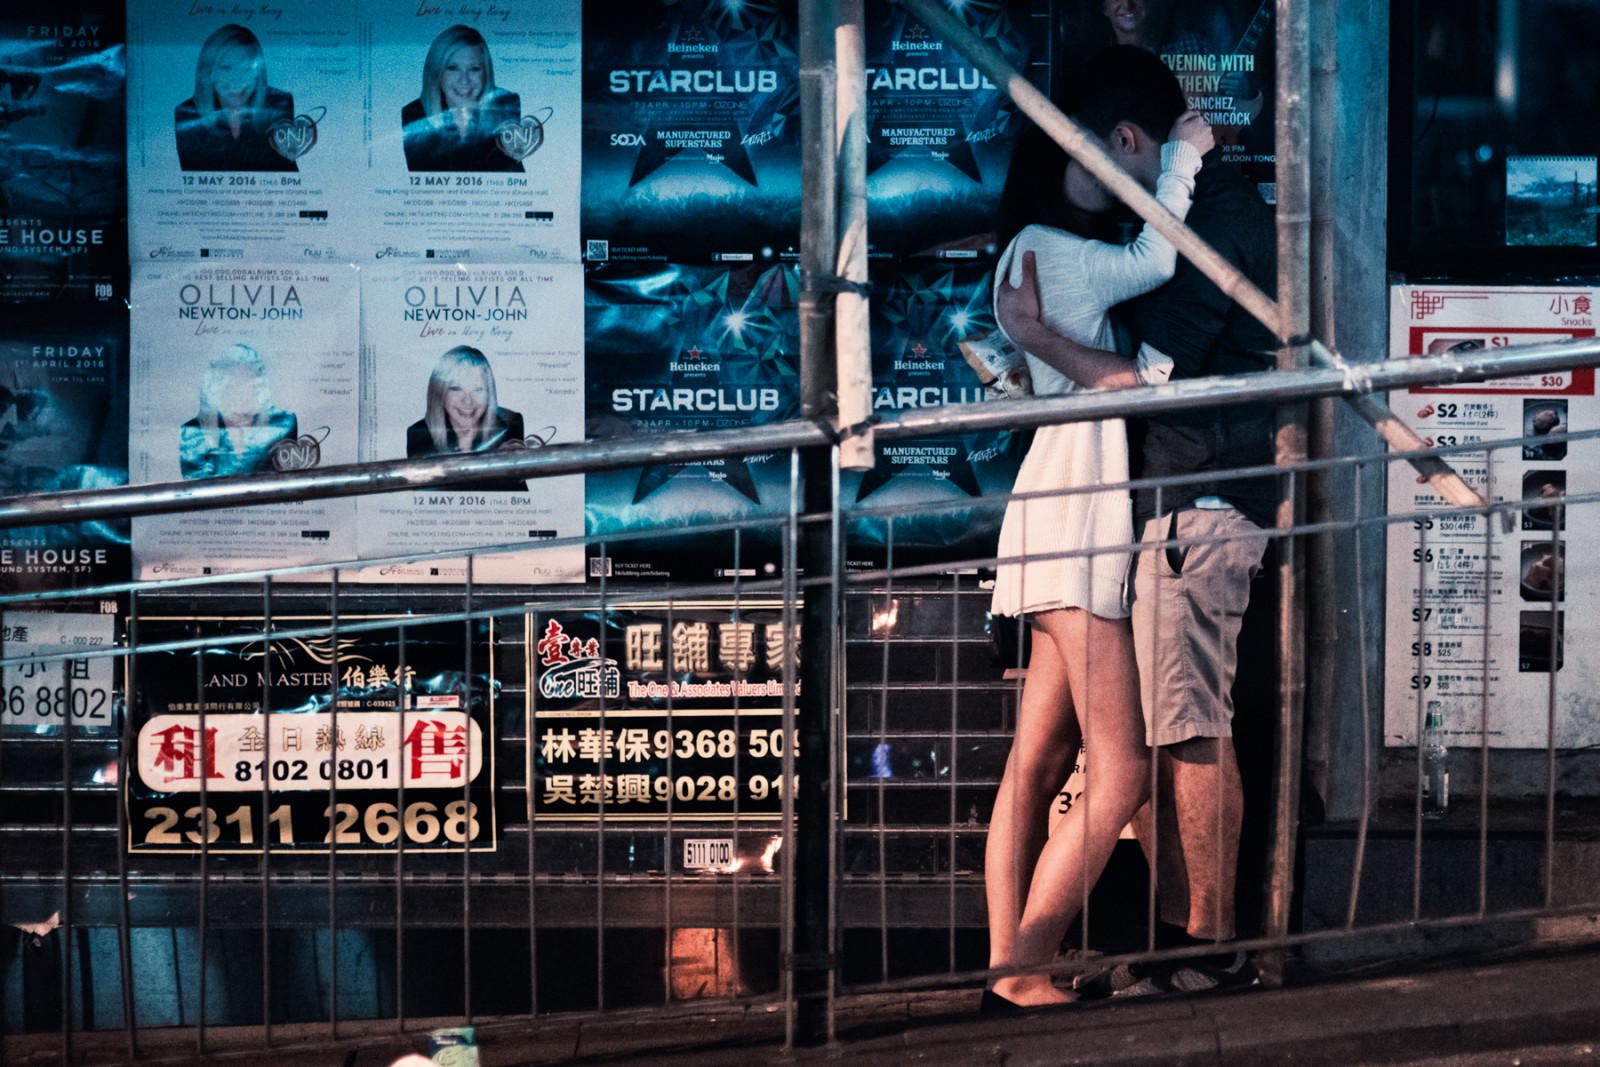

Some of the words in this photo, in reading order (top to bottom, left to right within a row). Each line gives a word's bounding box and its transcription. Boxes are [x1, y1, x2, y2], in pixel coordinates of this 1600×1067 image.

[416, 0, 441, 16] Live
[458, 4, 482, 22] Hong
[487, 5, 511, 22] Kong
[28, 26, 99, 36] FRIDAY
[668, 43, 718, 52] Heineken
[892, 41, 940, 50] Heineken
[1160, 55, 1216, 72] EVENING
[1220, 55, 1254, 72] WITH
[610, 70, 777, 92] STARCLUB
[866, 68, 998, 90] TARCLU
[1178, 76, 1221, 92] THENY
[1188, 97, 1236, 112] SANCHEZ,
[1204, 111, 1250, 125] SIMCOCK
[503, 127, 534, 148] ONJ
[657, 131, 730, 139] MANUFACTURED
[890, 137, 947, 145] SUPERSTARS
[665, 140, 722, 148] SUPERSTARS
[706, 154, 724, 162] Mojo
[931, 151, 949, 159] Mojo
[182, 176, 194, 185] 12
[198, 176, 224, 185] MAY
[229, 176, 256, 186] 2016
[280, 177, 302, 186] 8PM
[409, 177, 421, 186] 12
[425, 177, 450, 186] MAY
[456, 177, 483, 186] 2016
[506, 177, 528, 186] 8PM
[22, 230, 103, 244] HOUSE
[95, 283, 112, 297] FOB
[179, 284, 302, 306] OLIVIA
[404, 286, 527, 307] OLIVIA
[1549, 295, 1592, 316] 小食
[179, 307, 303, 320] NEWTON-JOHN
[404, 309, 528, 321] NEWTON-JOHN
[194, 319, 218, 336] Live
[1562, 317, 1592, 326] Snacks
[420, 320, 444, 338] Live
[461, 324, 486, 342] Hong
[490, 325, 514, 342] Kong
[32, 347, 104, 357] FRIDAY
[33, 360, 69, 368] APRIL
[76, 360, 104, 368] 2016
[670, 362, 720, 371] Heineken
[894, 360, 945, 370] Heineken
[1541, 376, 1563, 386] $30
[612, 389, 779, 411] STARCLUB
[1437, 404, 1457, 418] S2
[1437, 436, 1456, 447] S3
[279, 446, 313, 464] ONJ
[883, 447, 957, 455] MANUFACTURED
[892, 456, 948, 464] SUPERSTARS
[932, 470, 950, 478] Mojo
[413, 497, 424, 505] 12
[429, 497, 454, 505] MAY
[460, 497, 486, 506] 2016
[510, 497, 531, 505] 8PM
[1414, 518, 1433, 530] S5
[26, 550, 107, 564] HOUSE
[1413, 548, 1433, 562] S6
[100, 601, 118, 613] FOB
[1412, 608, 1432, 622] S7
[60, 636, 66, 646] C
[73, 636, 87, 646] 000
[89, 636, 103, 646] 227
[537, 618, 570, 666] 壹
[1412, 642, 1432, 656] S8
[203, 672, 248, 688] AND
[342, 664, 416, 688] 伯樂行
[1411, 675, 1432, 690] S9
[540, 677, 576, 698] One
[627, 680, 648, 697] The
[648, 680, 669, 697] One
[670, 680, 680, 697] &
[680, 680, 731, 697] Associates
[731, 680, 766, 697] Valuers
[36, 686, 106, 718] 8802
[238, 724, 385, 752] 全日熱線
[404, 720, 467, 780] 售
[541, 728, 650, 763] 林華保
[654, 730, 737, 758] 9368
[150, 724, 225, 783] 租
[235, 759, 308, 781] 8102
[319, 759, 388, 781] 0801
[654, 776, 737, 802] 9028
[1058, 792, 1082, 814] 3
[144, 800, 293, 844] 2311
[323, 800, 480, 844] 2668
[687, 843, 706, 863] 5111
[710, 843, 729, 863] 0100
